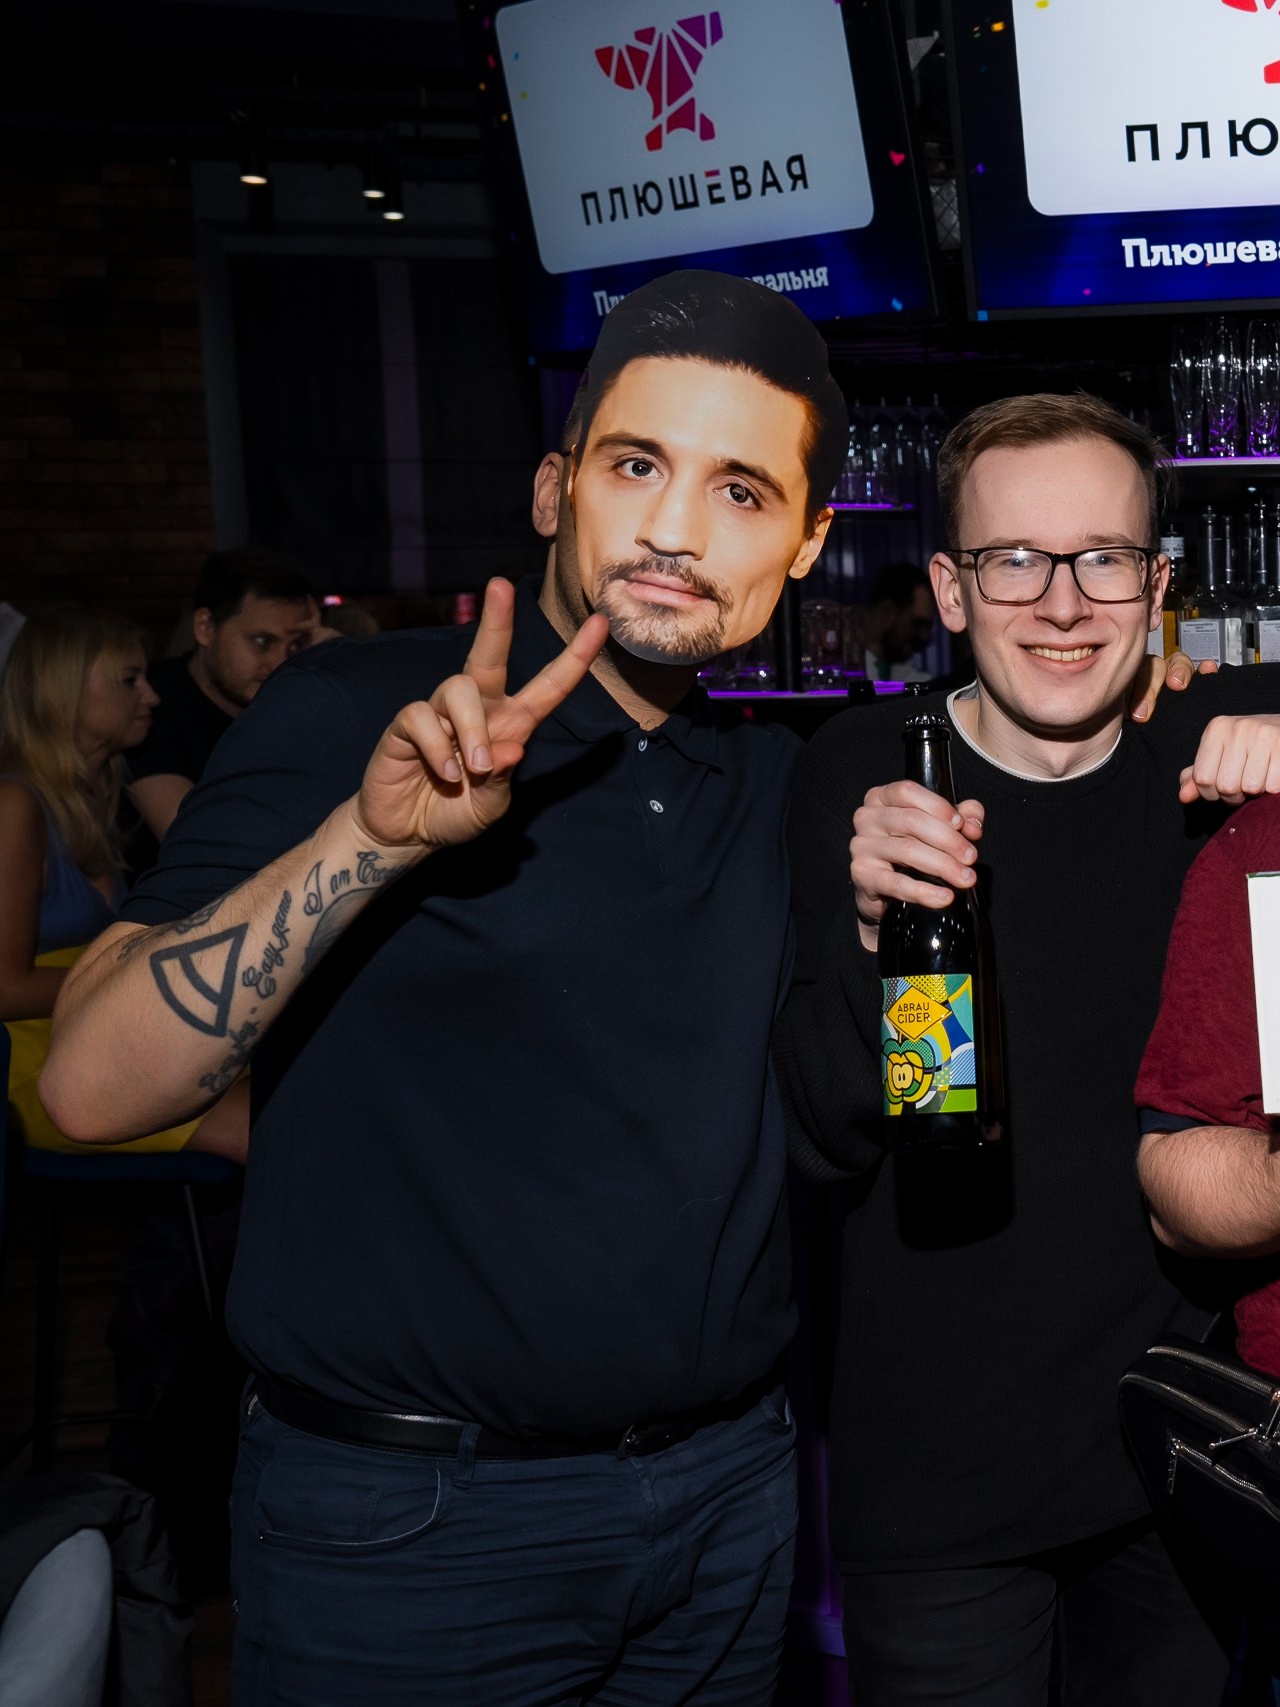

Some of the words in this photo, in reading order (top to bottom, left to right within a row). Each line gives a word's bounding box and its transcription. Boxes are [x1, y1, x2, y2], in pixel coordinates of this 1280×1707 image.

[580, 154, 809, 226] ПЛЮШЕВАЯ
[897, 1002, 930, 1012] ABRAU
[897, 1012, 931, 1024] CIDER
